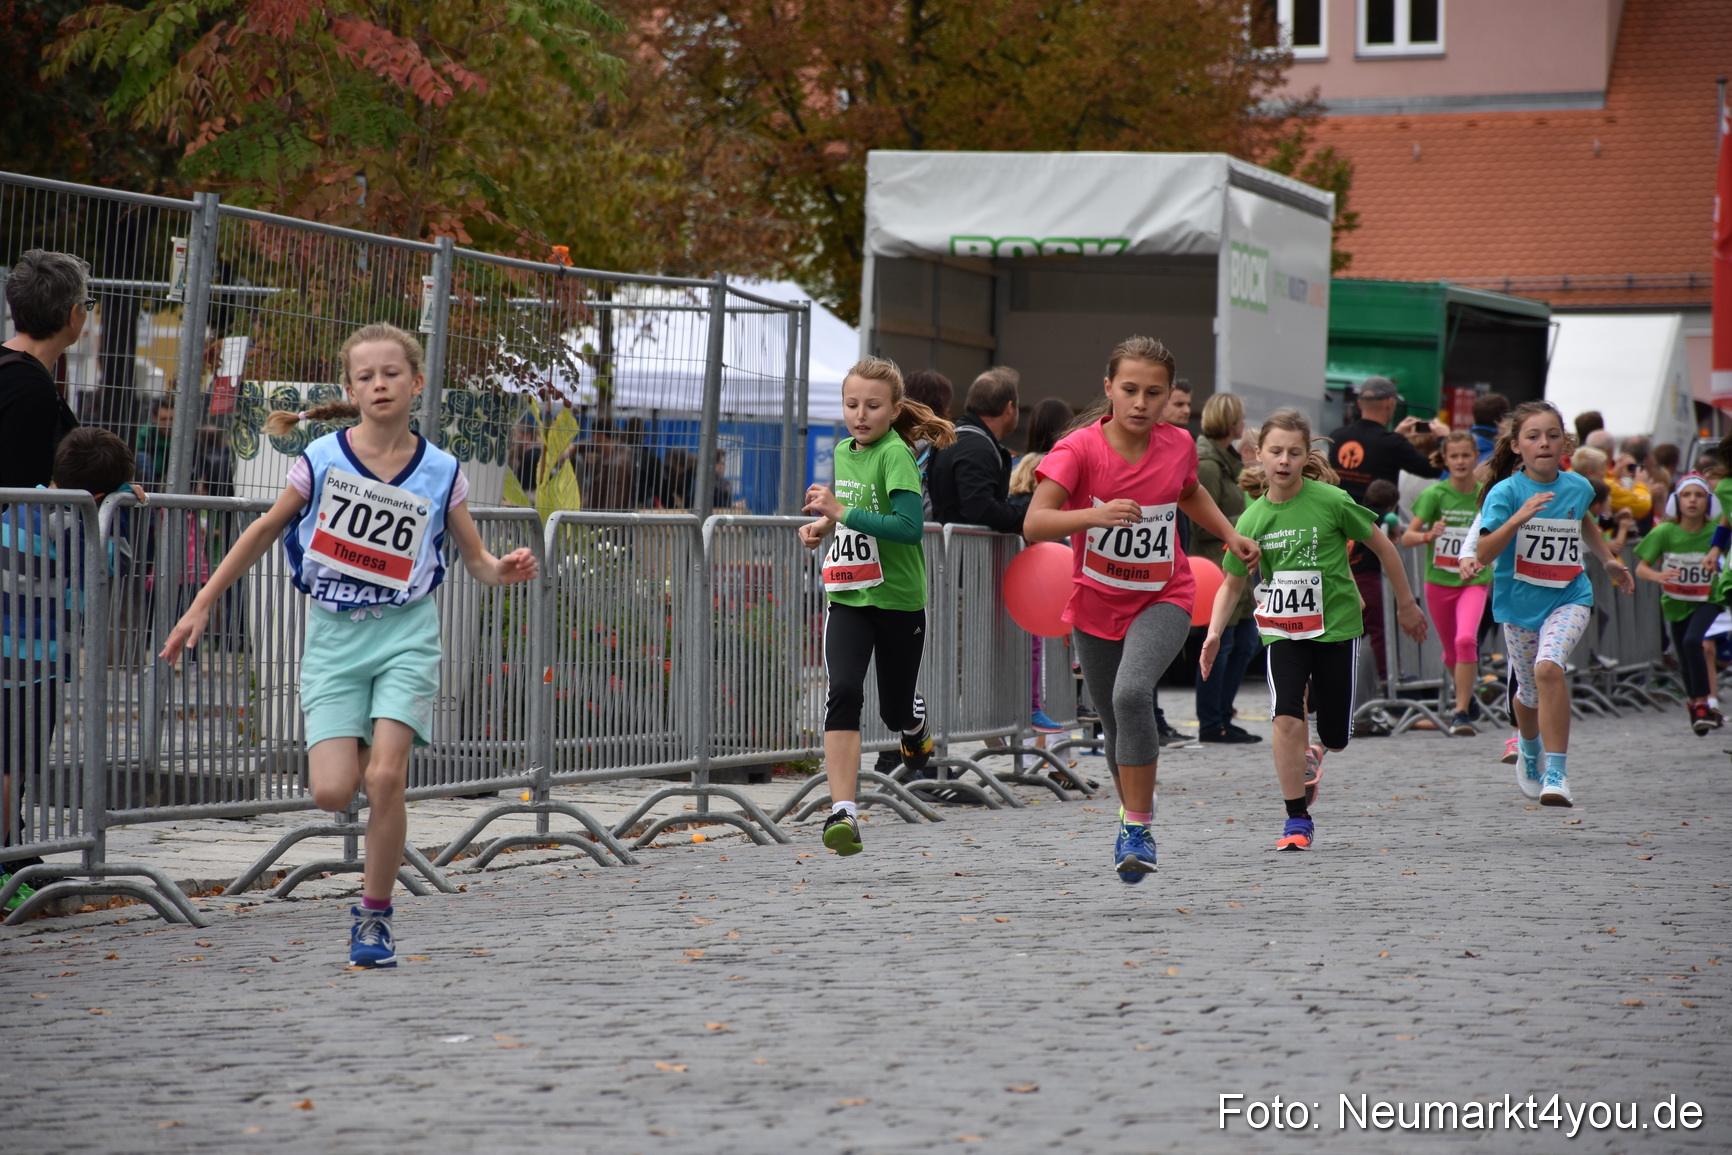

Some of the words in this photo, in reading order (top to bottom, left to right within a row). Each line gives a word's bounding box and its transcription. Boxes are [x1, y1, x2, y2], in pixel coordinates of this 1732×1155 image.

[327, 477, 361, 496] PARTL
[364, 489, 413, 511] Neumarkt
[328, 494, 417, 552] 7026
[1520, 524, 1546, 532] PARTL
[1547, 526, 1577, 534] Neumarkt
[1097, 526, 1168, 559] 7034
[1526, 535, 1579, 562] 7575
[334, 542, 387, 571] Theresa
[830, 570, 854, 581] Lena
[1106, 563, 1149, 580] Regina
[1260, 588, 1317, 614] 7044
